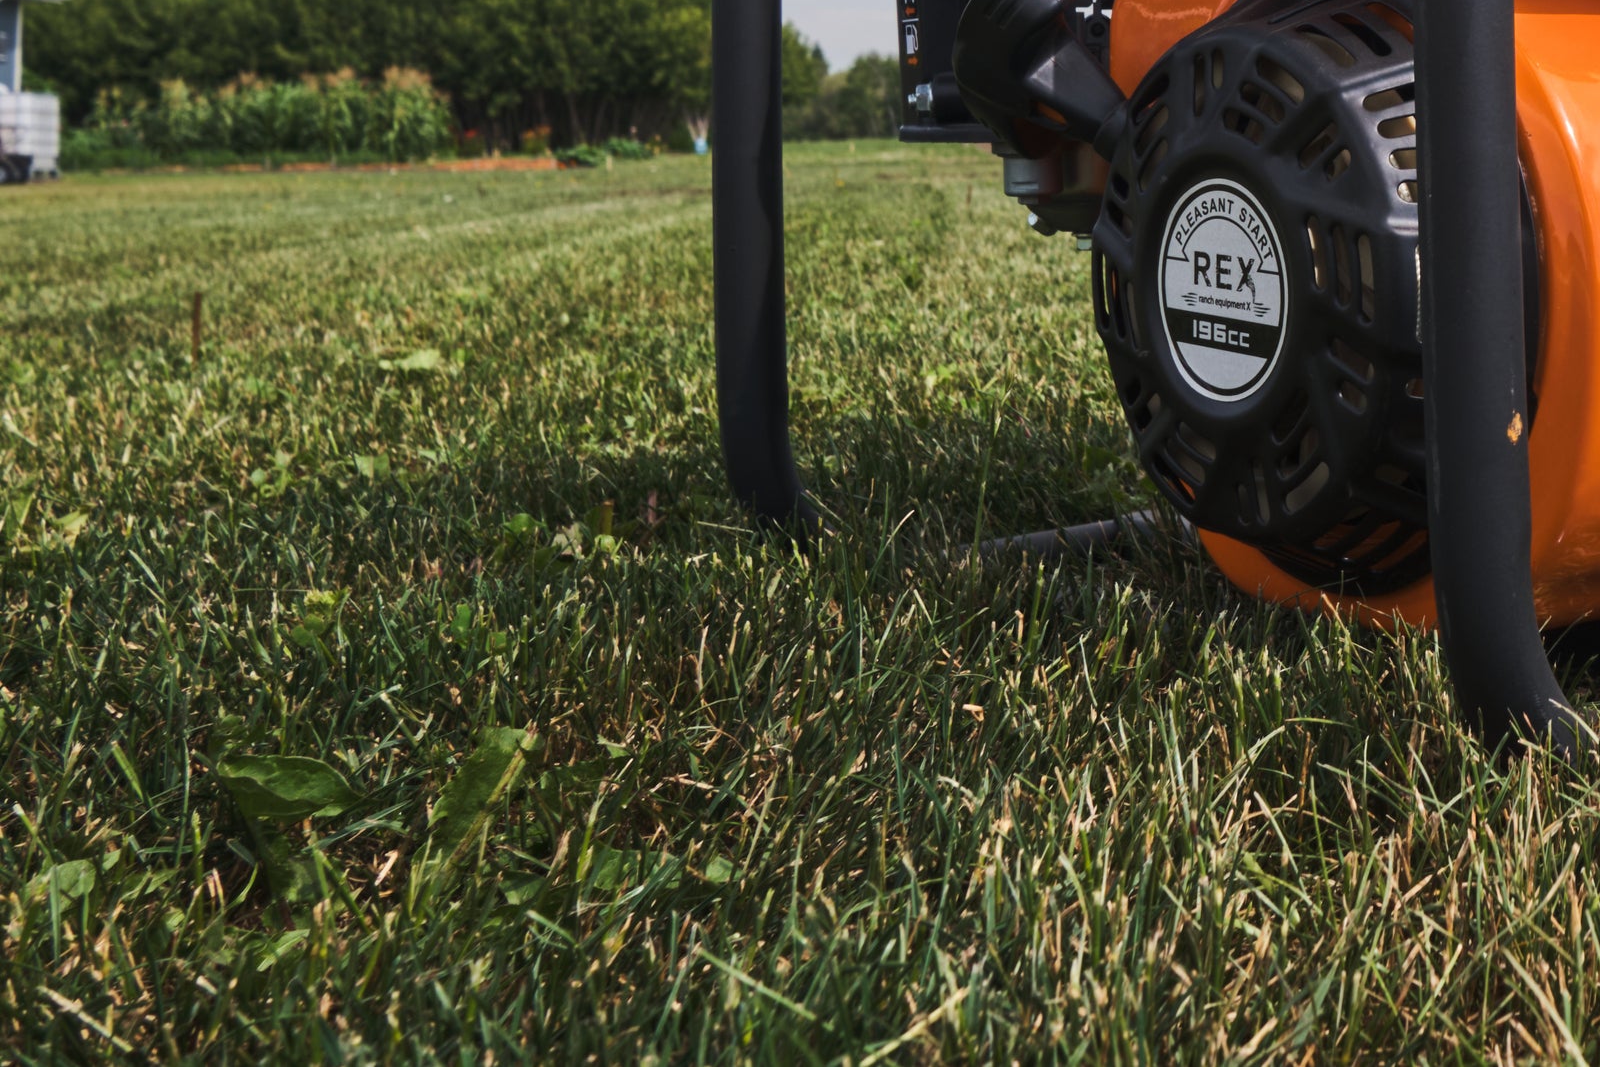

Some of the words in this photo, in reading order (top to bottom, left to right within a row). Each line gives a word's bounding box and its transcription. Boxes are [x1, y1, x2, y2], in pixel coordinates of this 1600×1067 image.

[1175, 197, 1234, 245] PLEASANT
[1239, 208, 1274, 260] START
[1194, 250, 1256, 297] REX
[1199, 295, 1215, 305] ranch
[1215, 298, 1245, 310] equipment
[1246, 301, 1251, 311] X
[1193, 319, 1250, 347] 196cc
